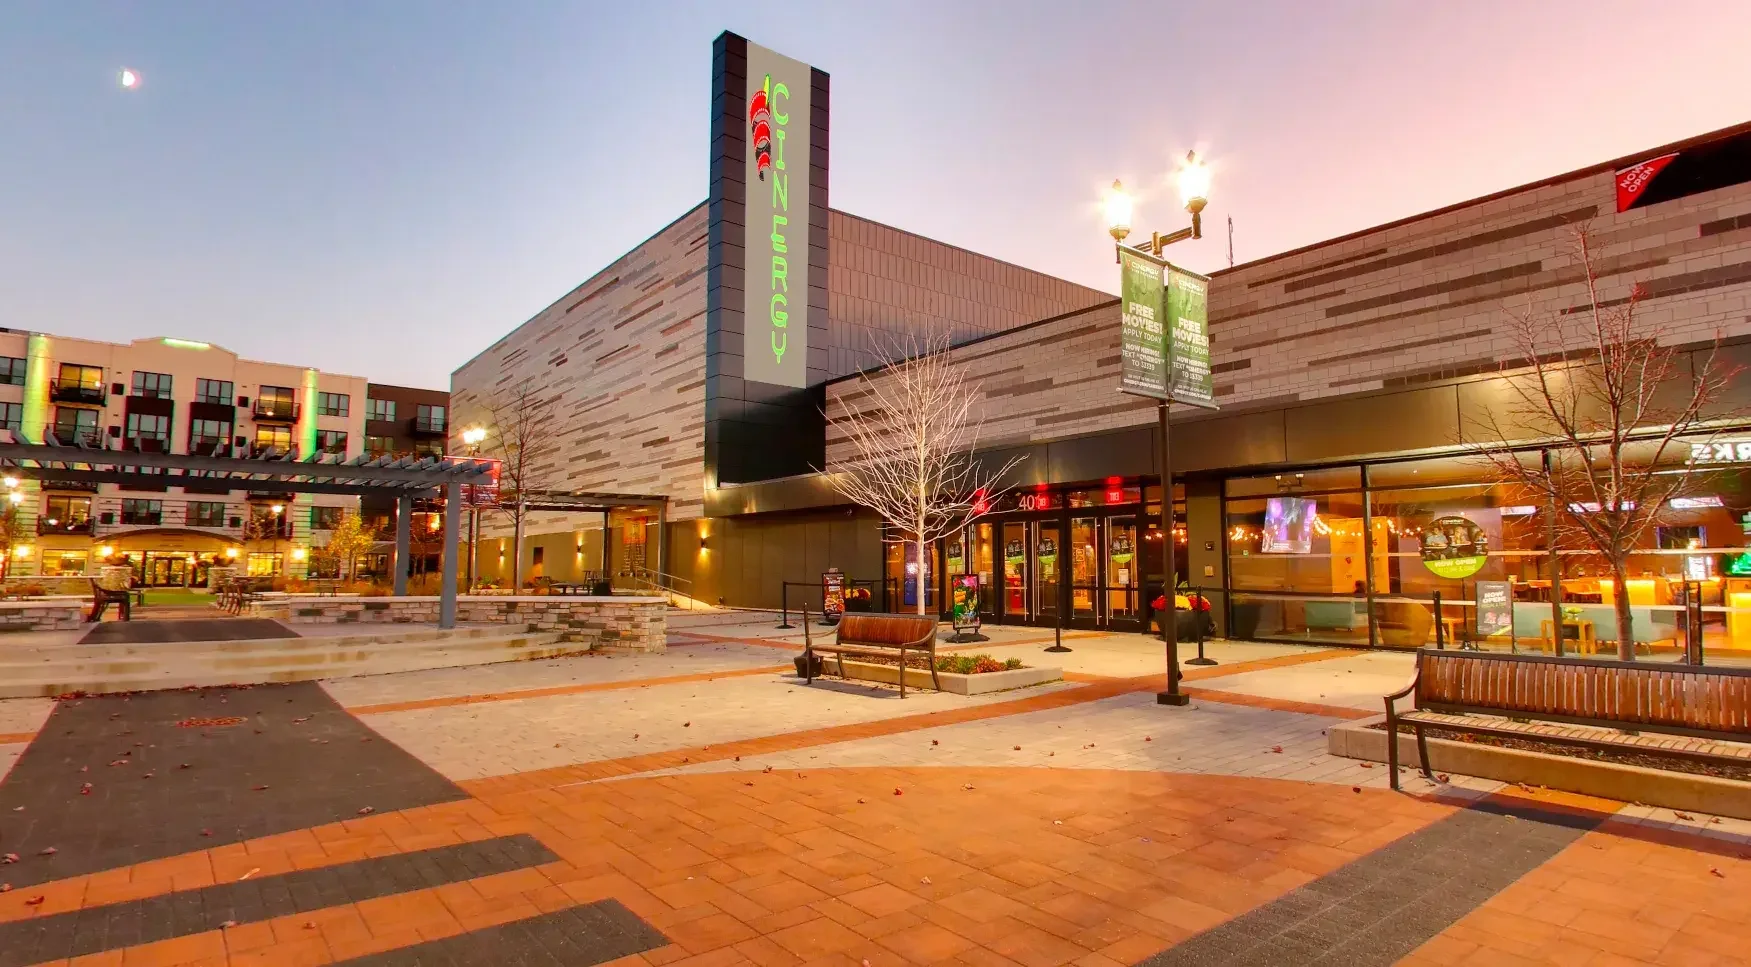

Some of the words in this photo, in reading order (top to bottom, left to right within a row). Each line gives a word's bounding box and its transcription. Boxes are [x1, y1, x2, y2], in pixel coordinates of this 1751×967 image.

[1620, 165, 1645, 188] NOW
[1628, 166, 1655, 193] OPEN
[770, 83, 790, 364] CINERGY
[1131, 261, 1159, 275] CINERGY
[1129, 302, 1154, 320] FREE
[1122, 312, 1163, 334] MOVIES!
[1178, 317, 1201, 334] FREE
[1123, 327, 1142, 338] APPLY
[1144, 332, 1162, 344] TODAY
[1172, 326, 1209, 347] MOVIES!
[1122, 349, 1135, 358] TEXT
[1125, 342, 1140, 351] NOW
[1173, 341, 1189, 351] APPLY
[1190, 345, 1209, 356] TODAY
[1132, 359, 1140, 367] TO
[1172, 361, 1185, 370] TEXT
[1176, 355, 1188, 363] NOW
